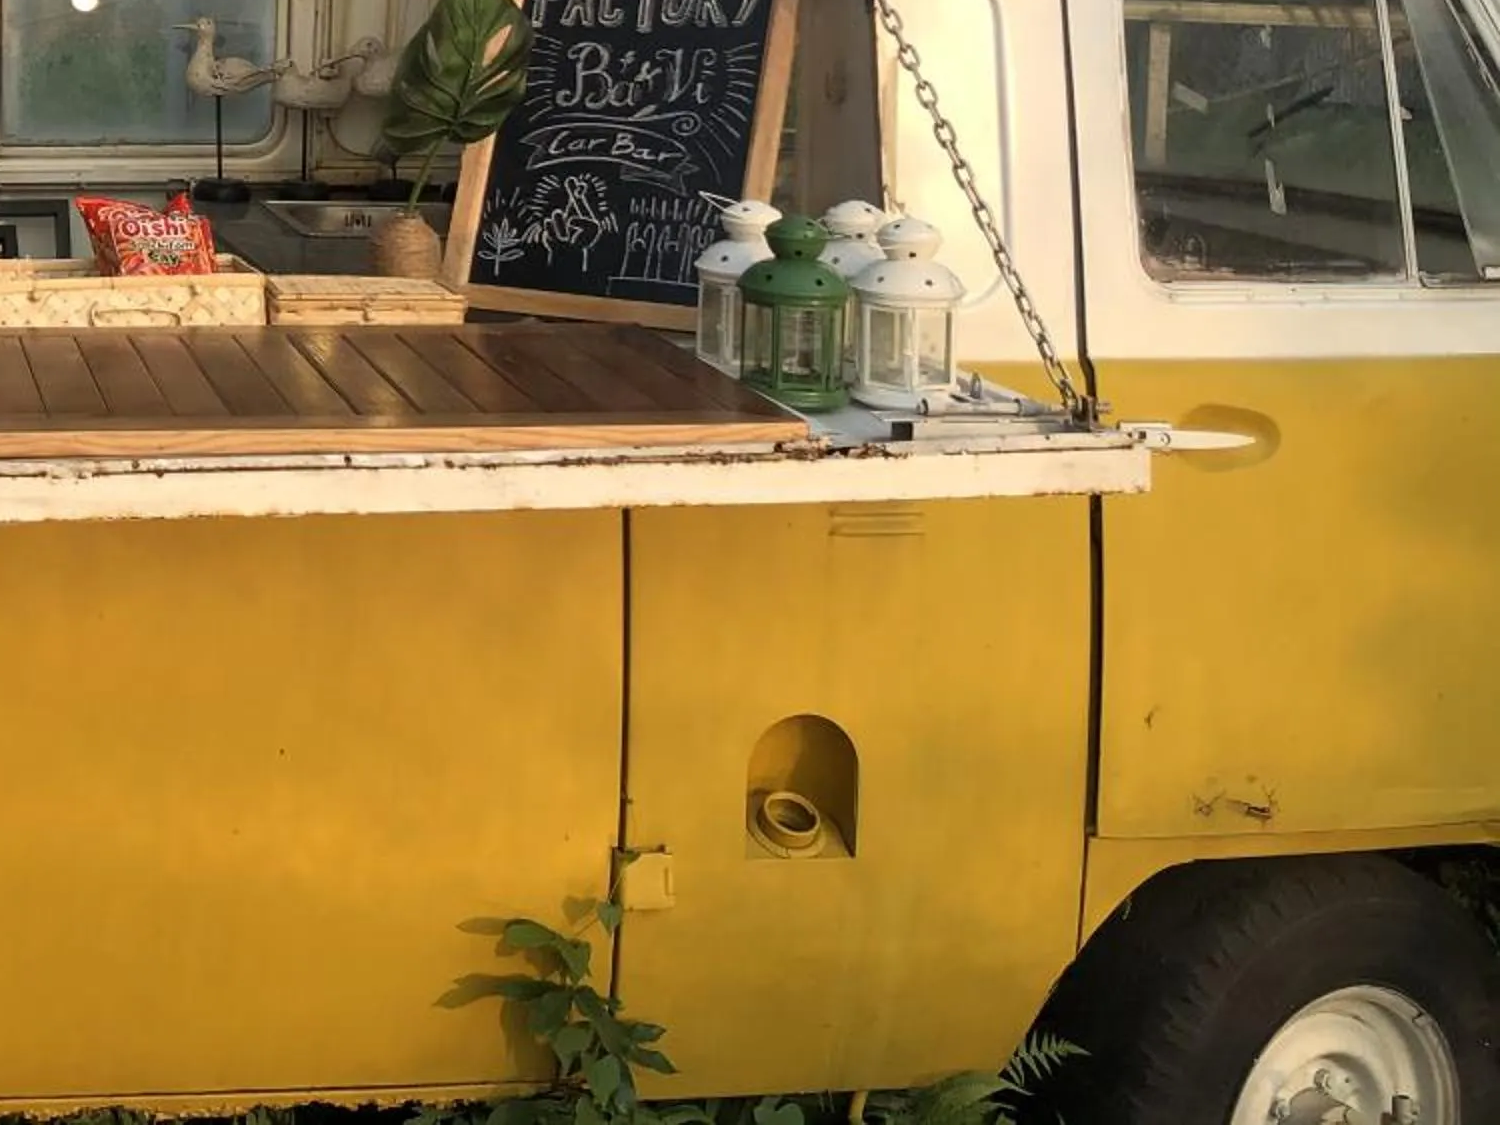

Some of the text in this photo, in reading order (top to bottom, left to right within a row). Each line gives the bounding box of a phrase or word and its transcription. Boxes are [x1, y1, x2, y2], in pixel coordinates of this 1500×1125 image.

[547, 130, 685, 163] Car Bar
[120, 216, 188, 238] Oishi
